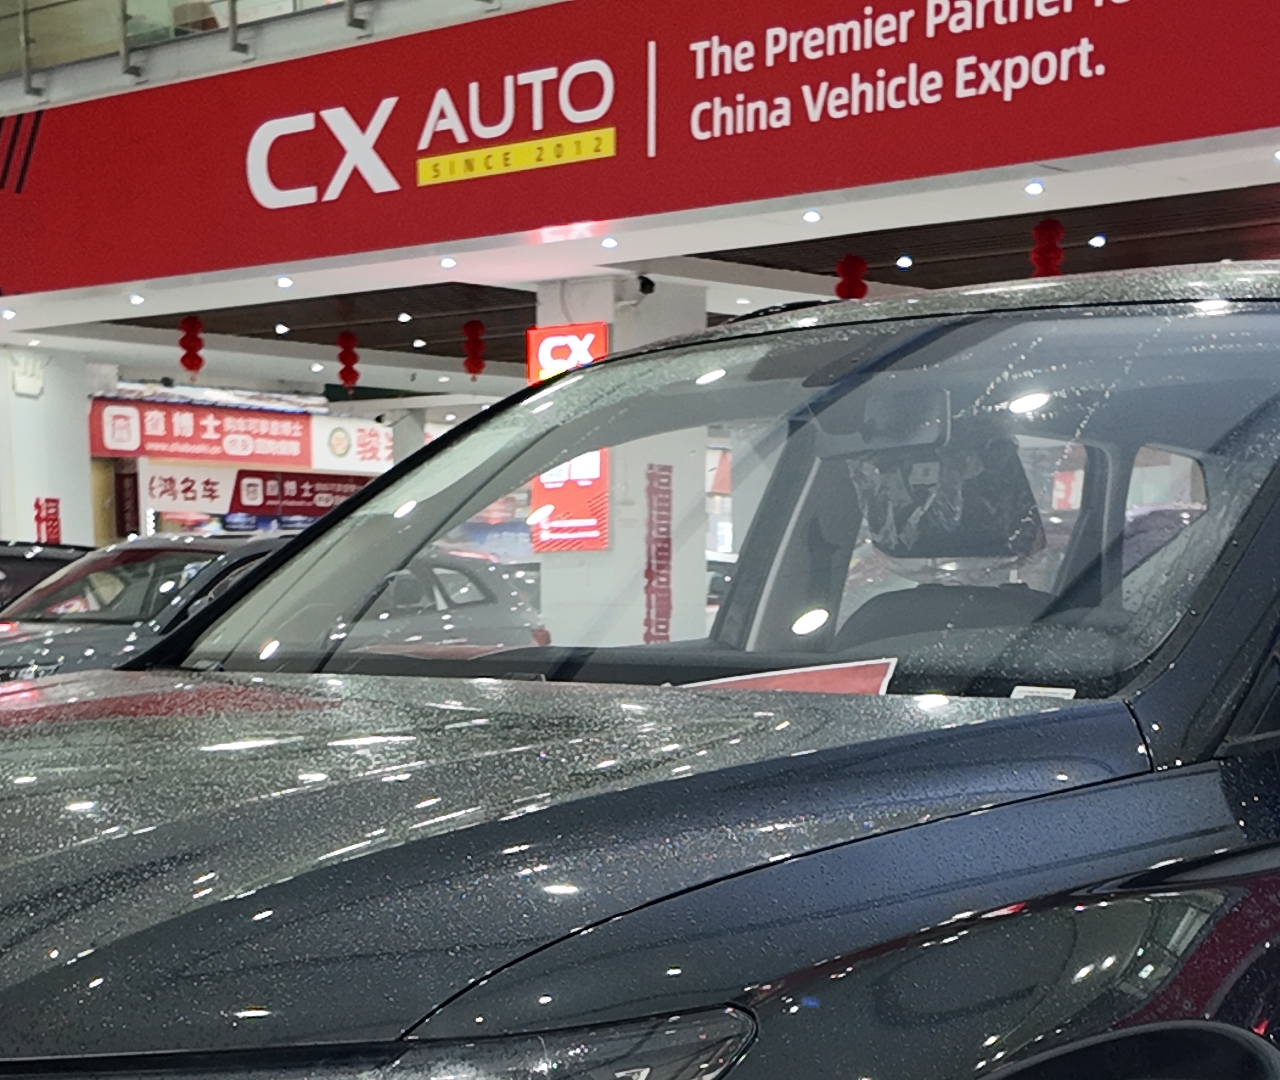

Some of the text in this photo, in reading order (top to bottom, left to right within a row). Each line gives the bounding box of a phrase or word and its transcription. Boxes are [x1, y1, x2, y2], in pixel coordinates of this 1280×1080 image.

[689, 35, 755, 80] The
[765, 6, 915, 67] Premier
[690, 37, 1106, 141] China Vehicle Export.
[246, 59, 615, 209] CX AUTO
[431, 135, 606, 179] SINCE 2012
[144, 411, 221, 440] 查博士
[356, 427, 394, 462] 骏
